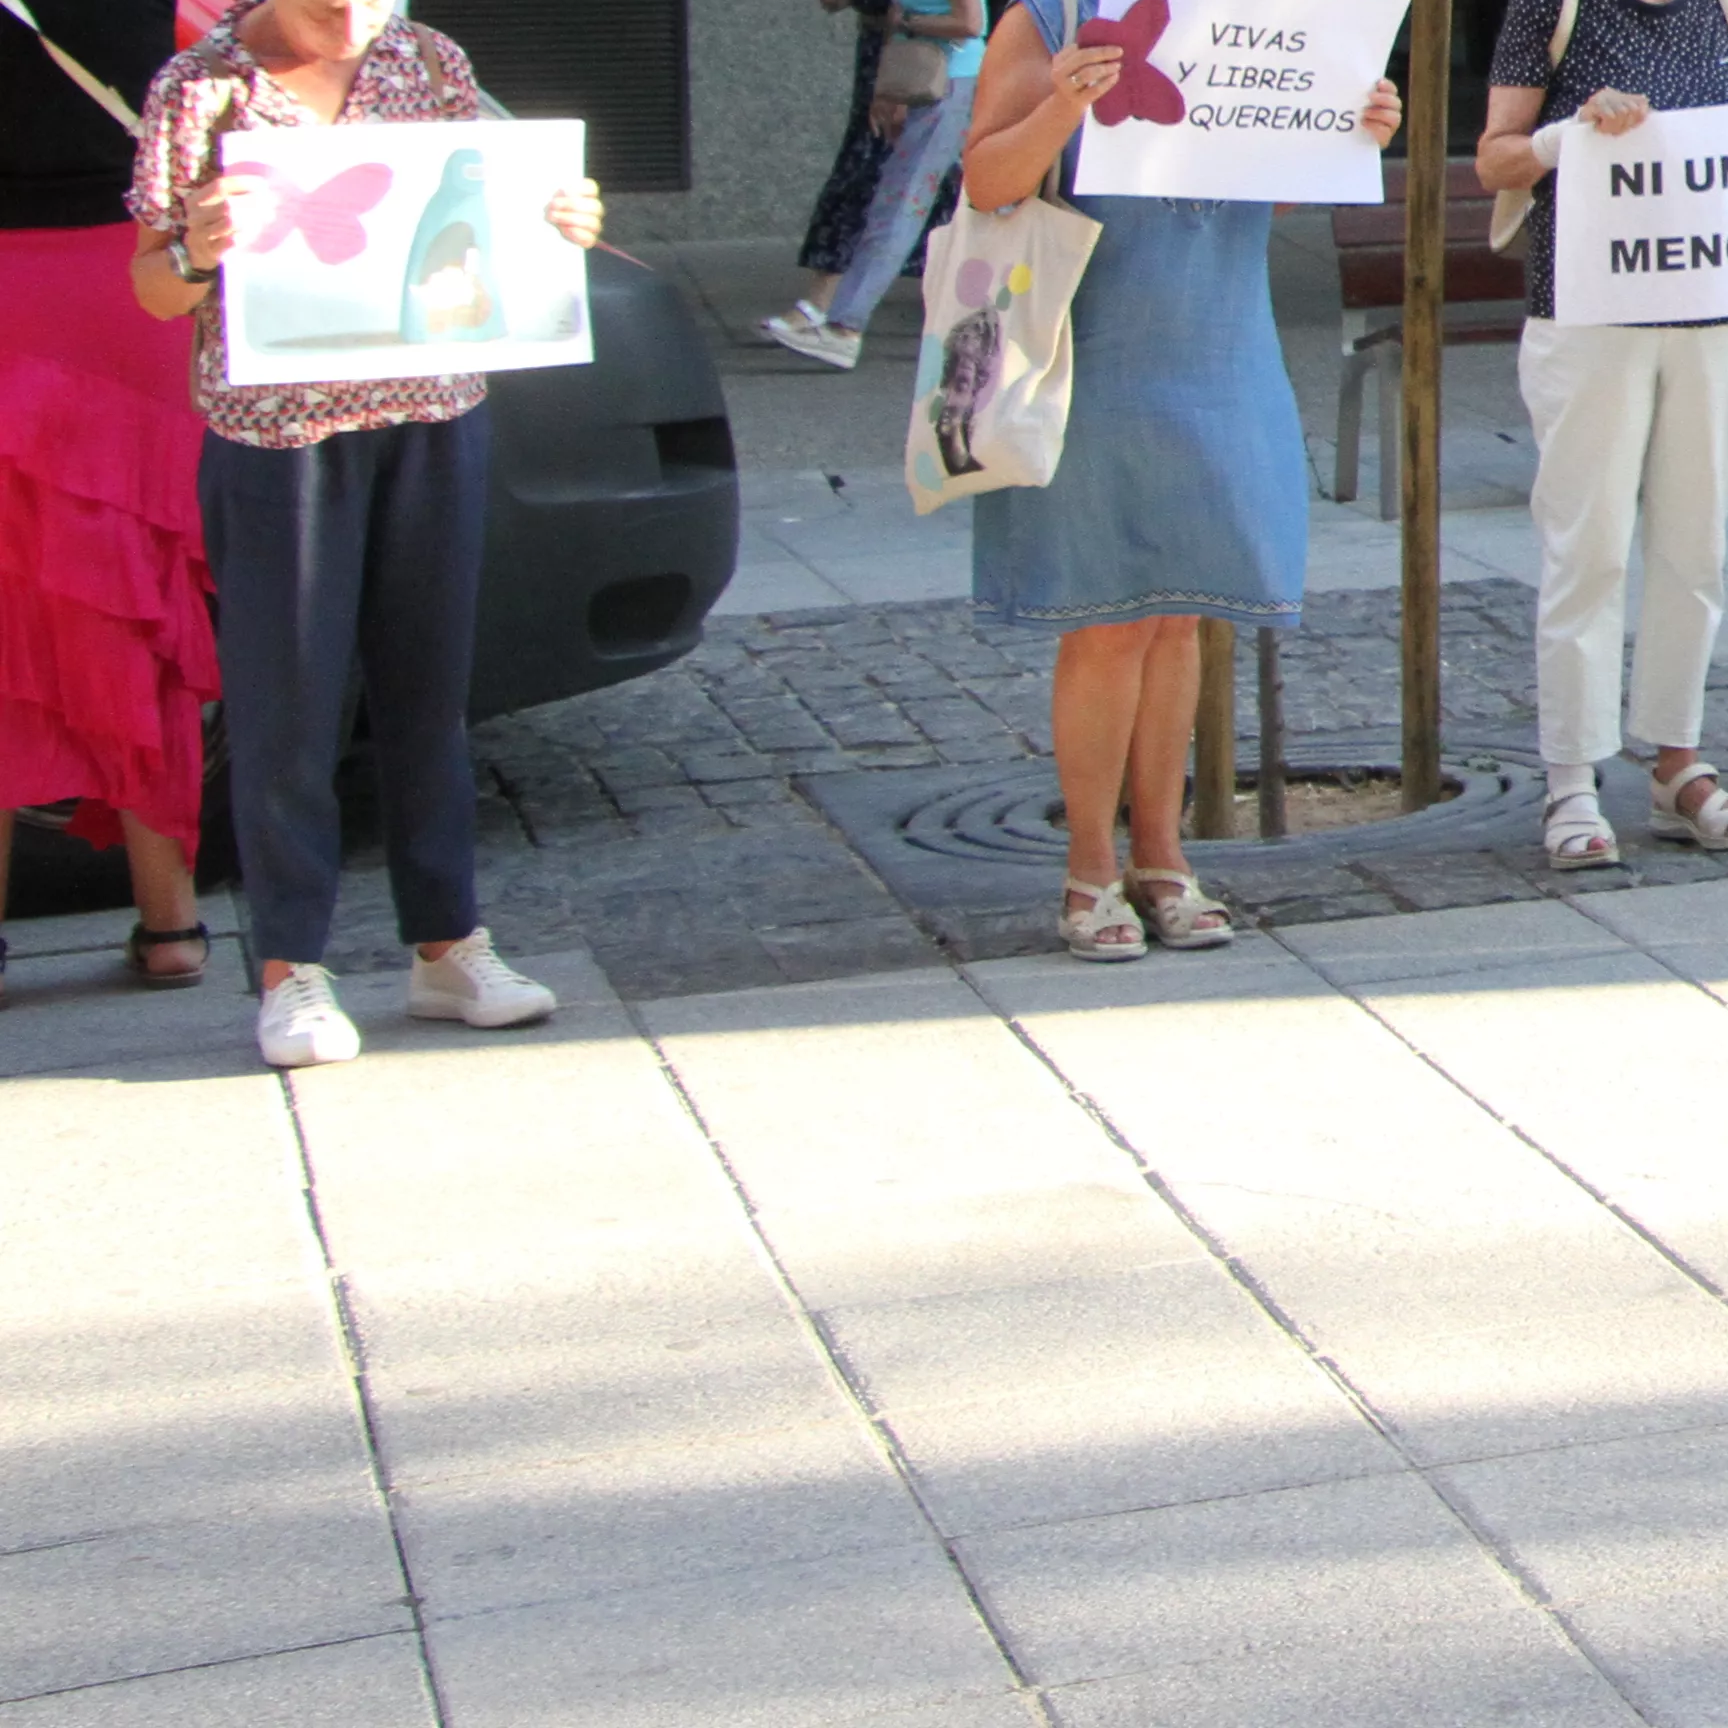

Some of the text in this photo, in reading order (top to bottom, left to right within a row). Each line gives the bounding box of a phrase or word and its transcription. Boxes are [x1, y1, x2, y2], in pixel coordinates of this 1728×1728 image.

[1210, 22, 1307, 53] VIVAS
[1177, 60, 1316, 92] Y LIBRES
[1189, 103, 1356, 134] QUEREMOS
[1610, 161, 1663, 197] NI
